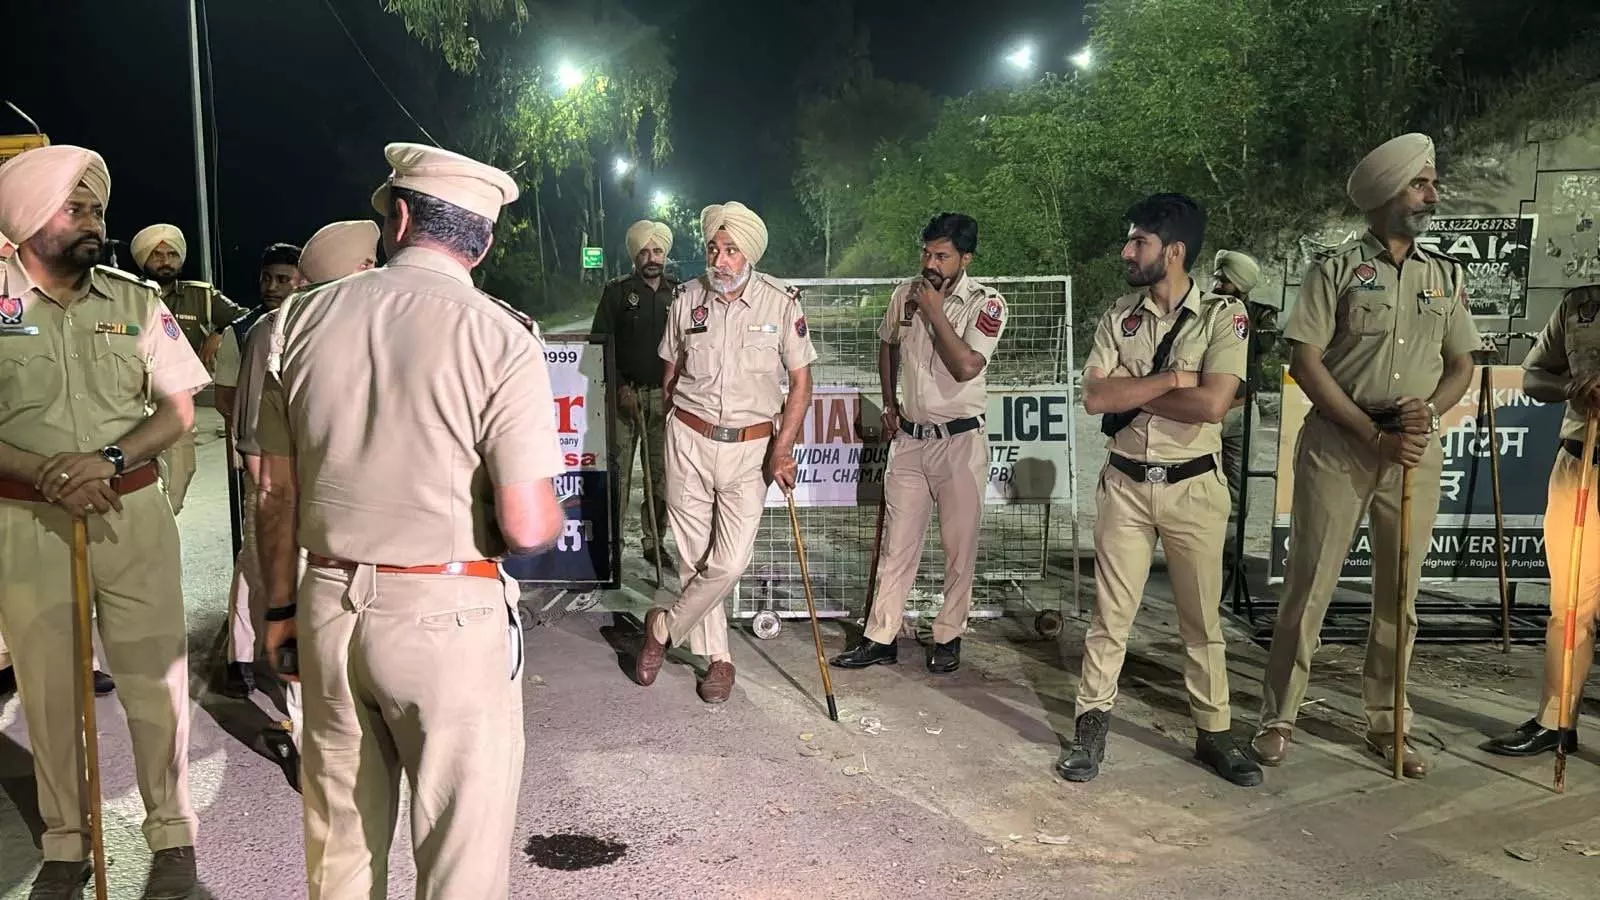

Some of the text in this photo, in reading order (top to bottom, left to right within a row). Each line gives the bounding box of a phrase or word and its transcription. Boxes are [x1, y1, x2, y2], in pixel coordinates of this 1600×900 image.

[1467, 262, 1509, 277] STORE
[988, 396, 1066, 441] ICE
[1511, 559, 1545, 569] Punjab
